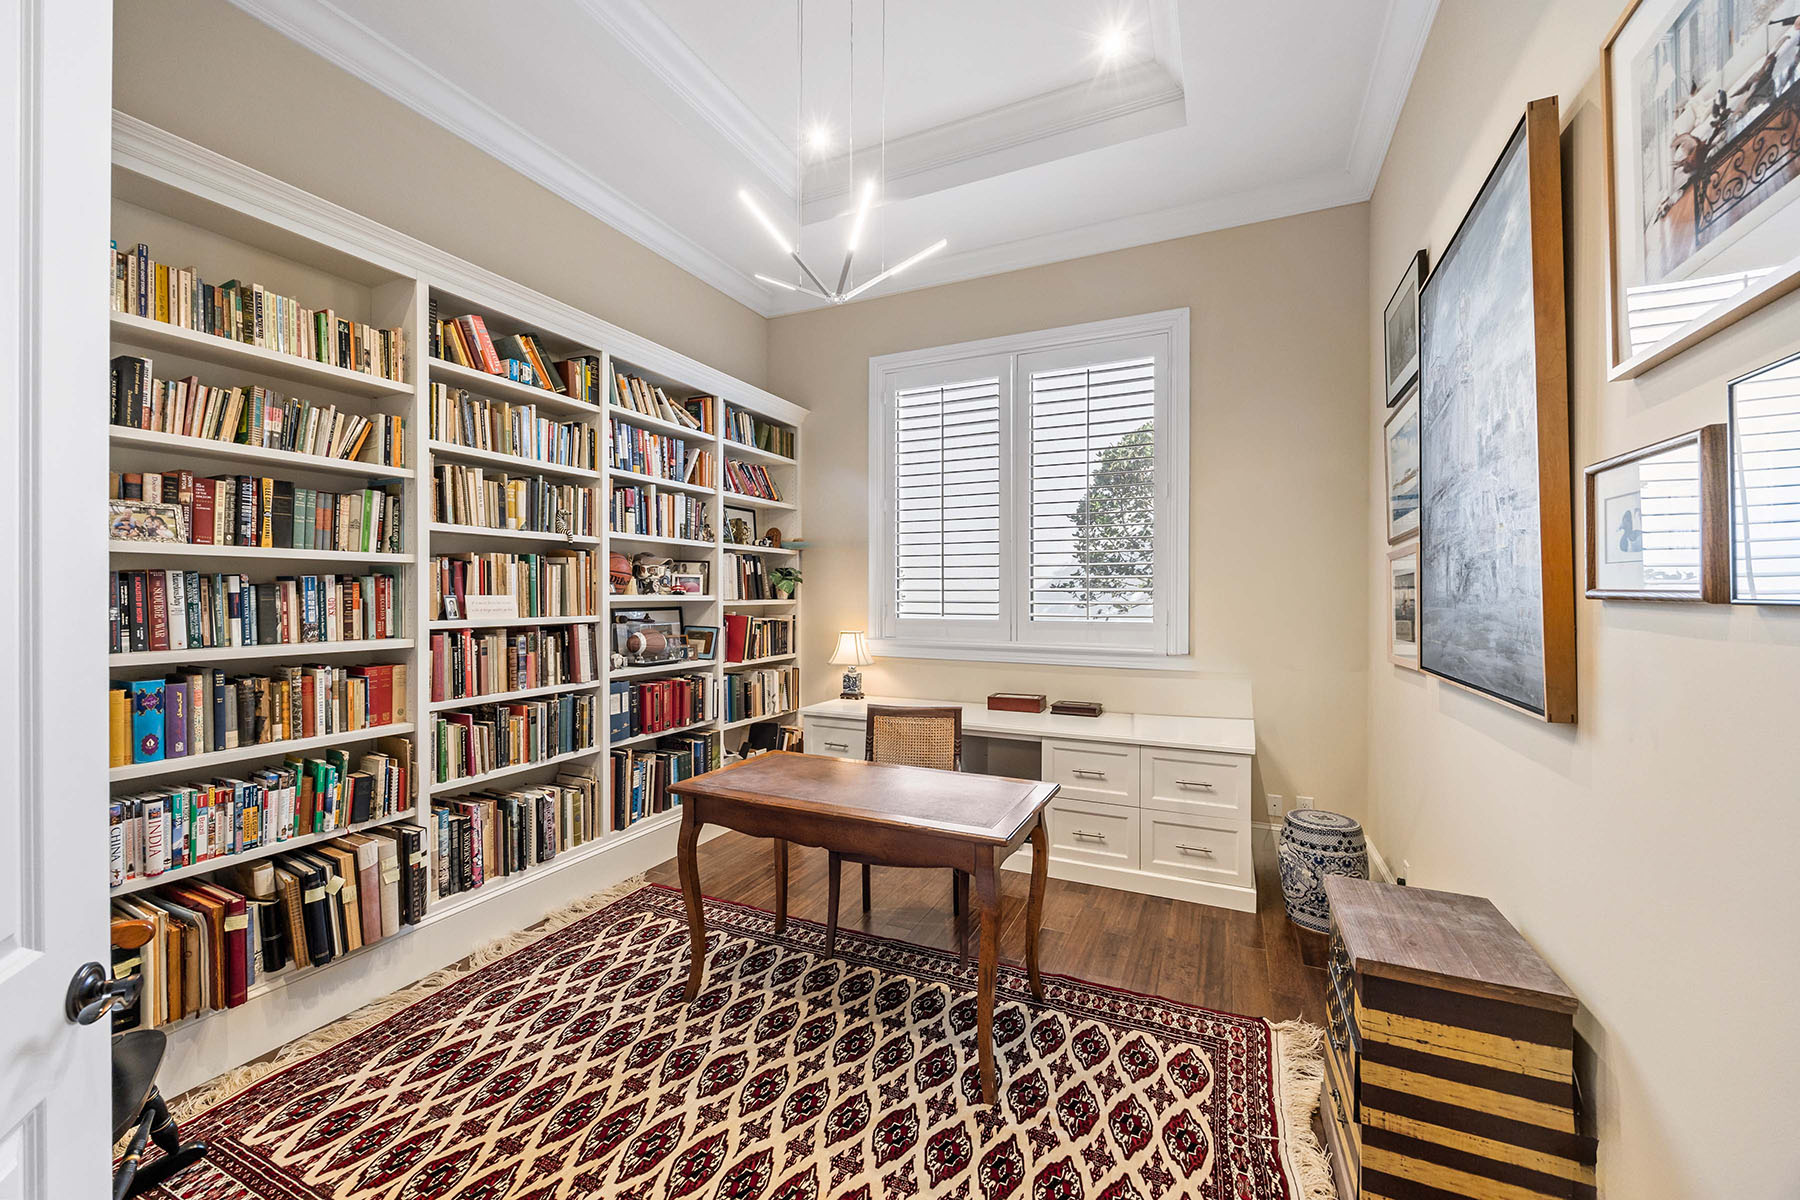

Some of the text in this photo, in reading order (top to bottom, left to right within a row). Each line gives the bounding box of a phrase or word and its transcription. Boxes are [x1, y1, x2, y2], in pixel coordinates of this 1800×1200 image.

[242, 483, 252, 521] SCOTT TUROW
[264, 497, 272, 510] CHILD
[153, 588, 164, 618] SCOURGE
[155, 623, 165, 638] WAR
[111, 827, 121, 863] CHINA
[149, 820, 162, 858] INDIA
[463, 831, 472, 877] MODERN ART
